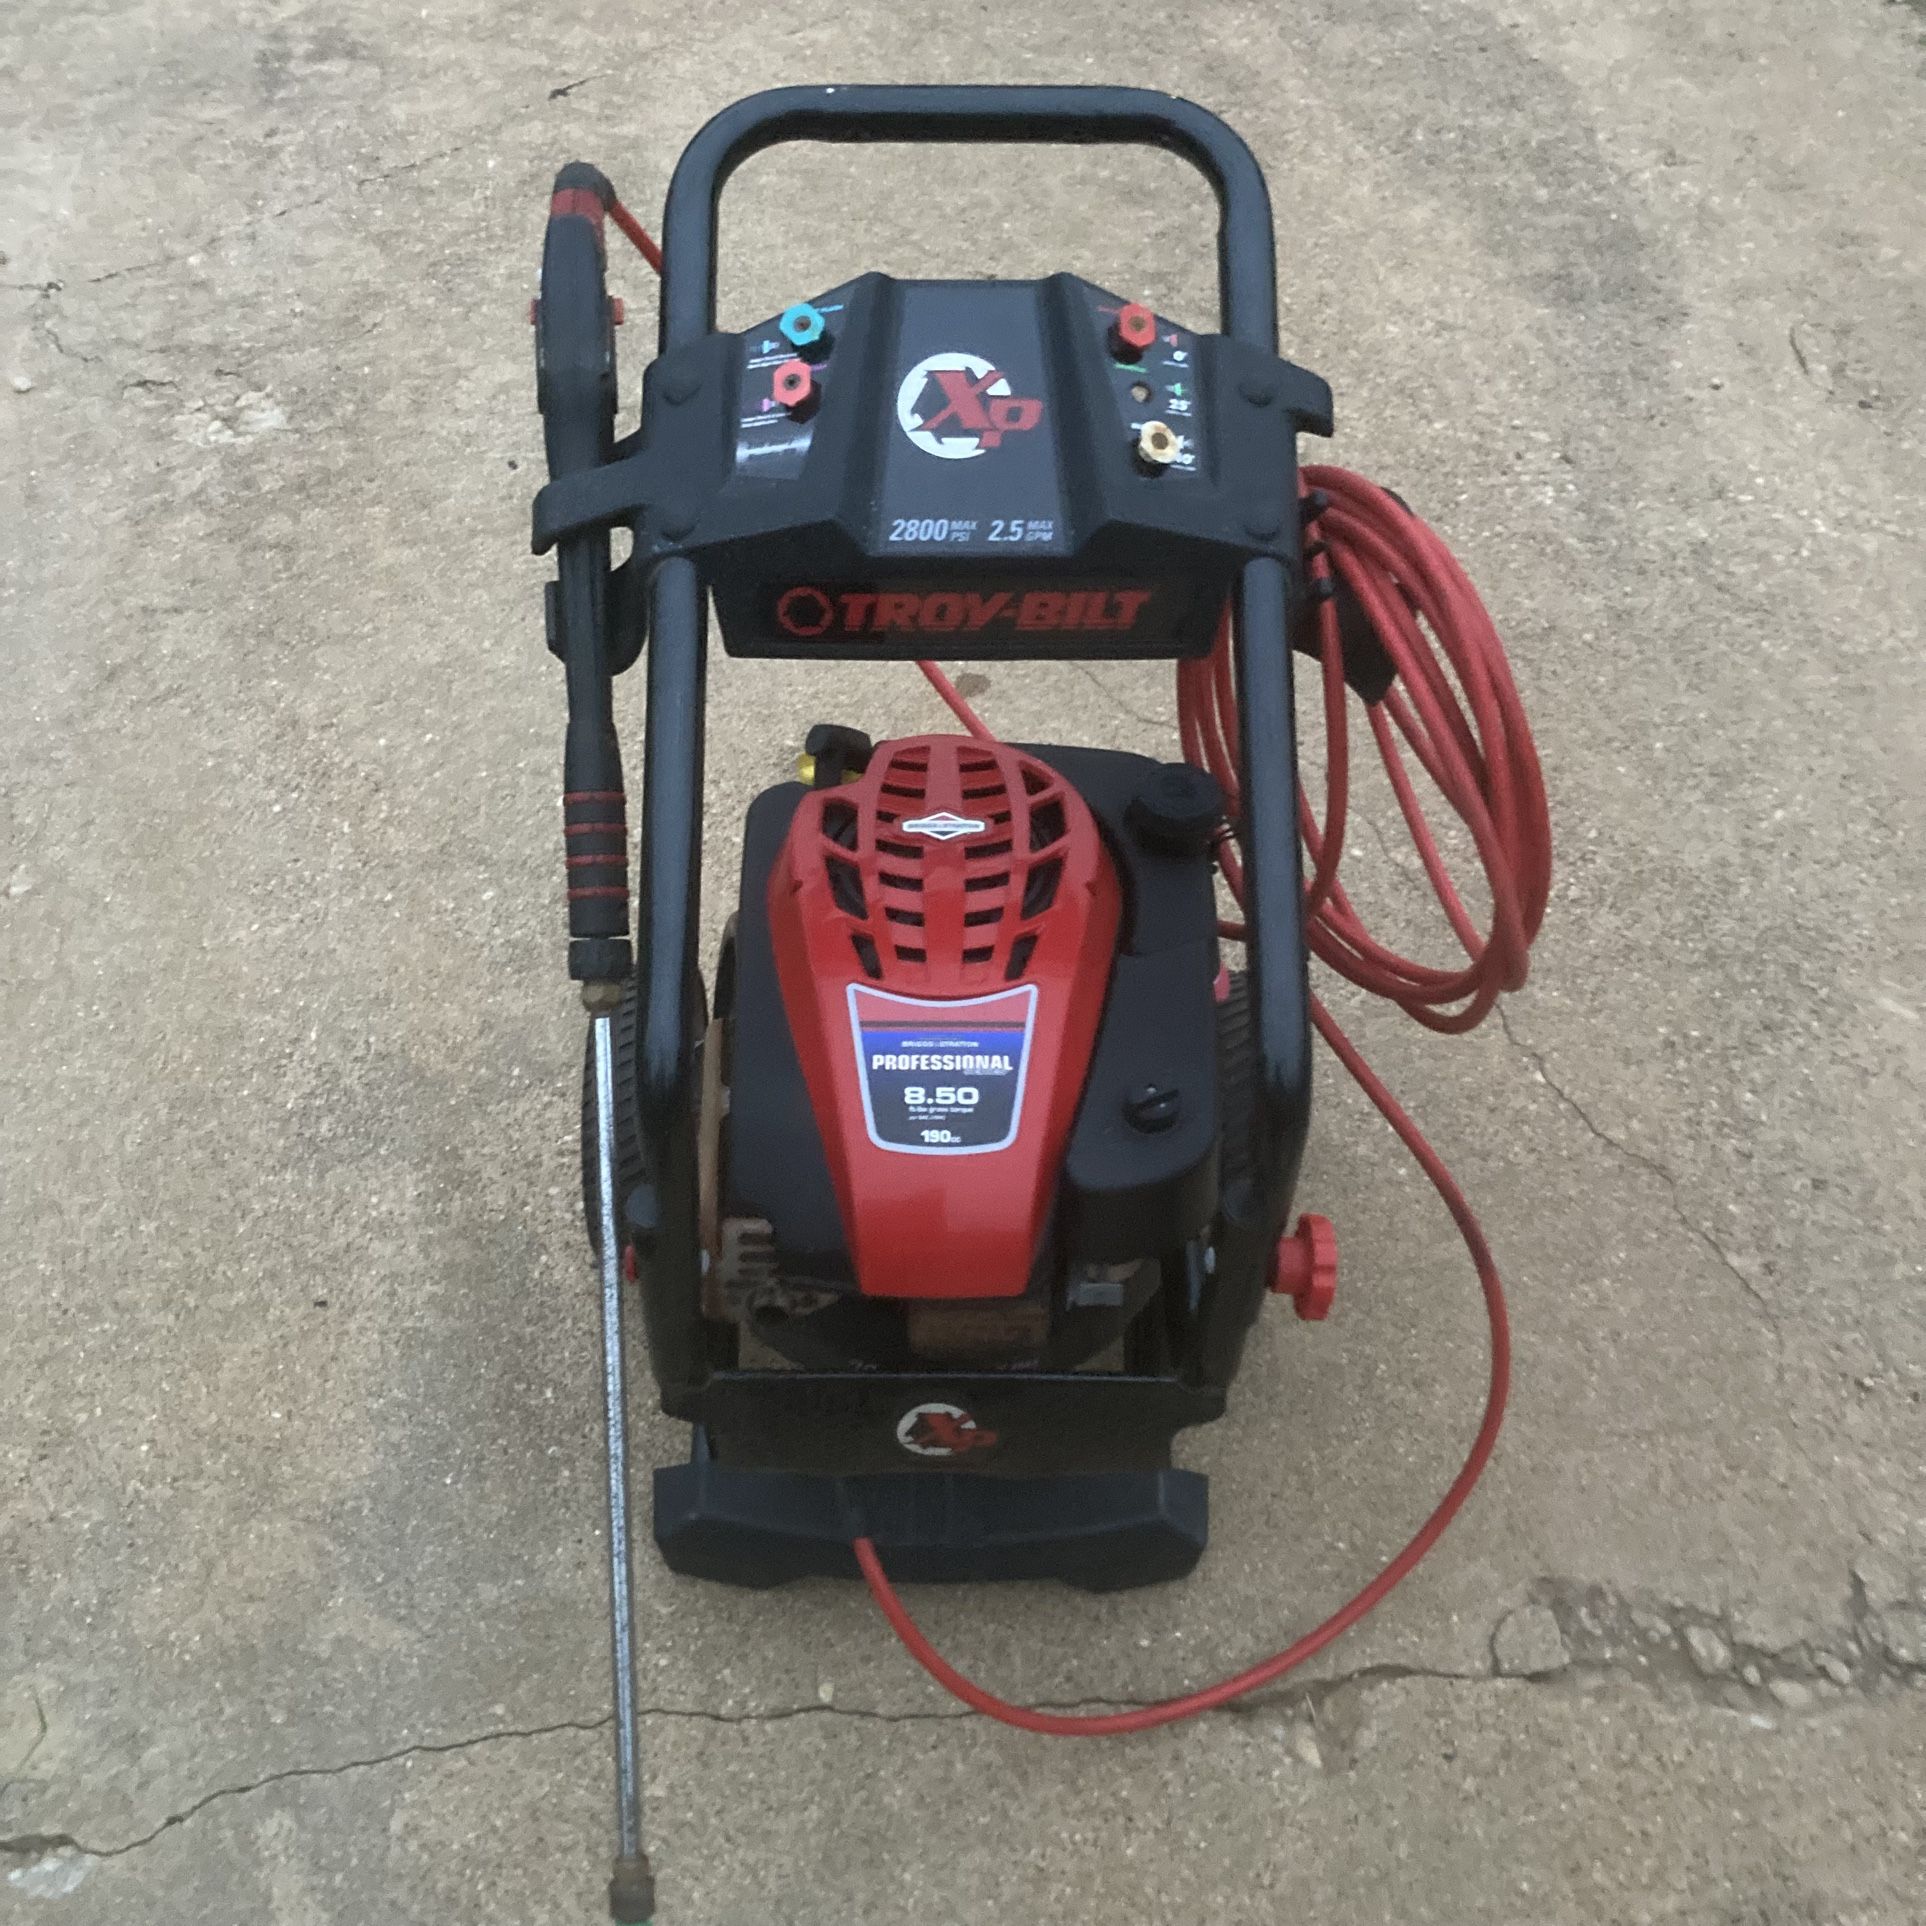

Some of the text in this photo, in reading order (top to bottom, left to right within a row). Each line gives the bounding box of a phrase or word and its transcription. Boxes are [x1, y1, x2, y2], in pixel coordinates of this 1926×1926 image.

[889, 518, 1054, 542] 2800 MAX 2.5 MAX
[949, 531, 972, 542] PSI
[839, 590, 1152, 632] TROY-BILT
[872, 1054, 1014, 1071] PROFESSIONAL
[904, 1086, 979, 1105] 8.50
